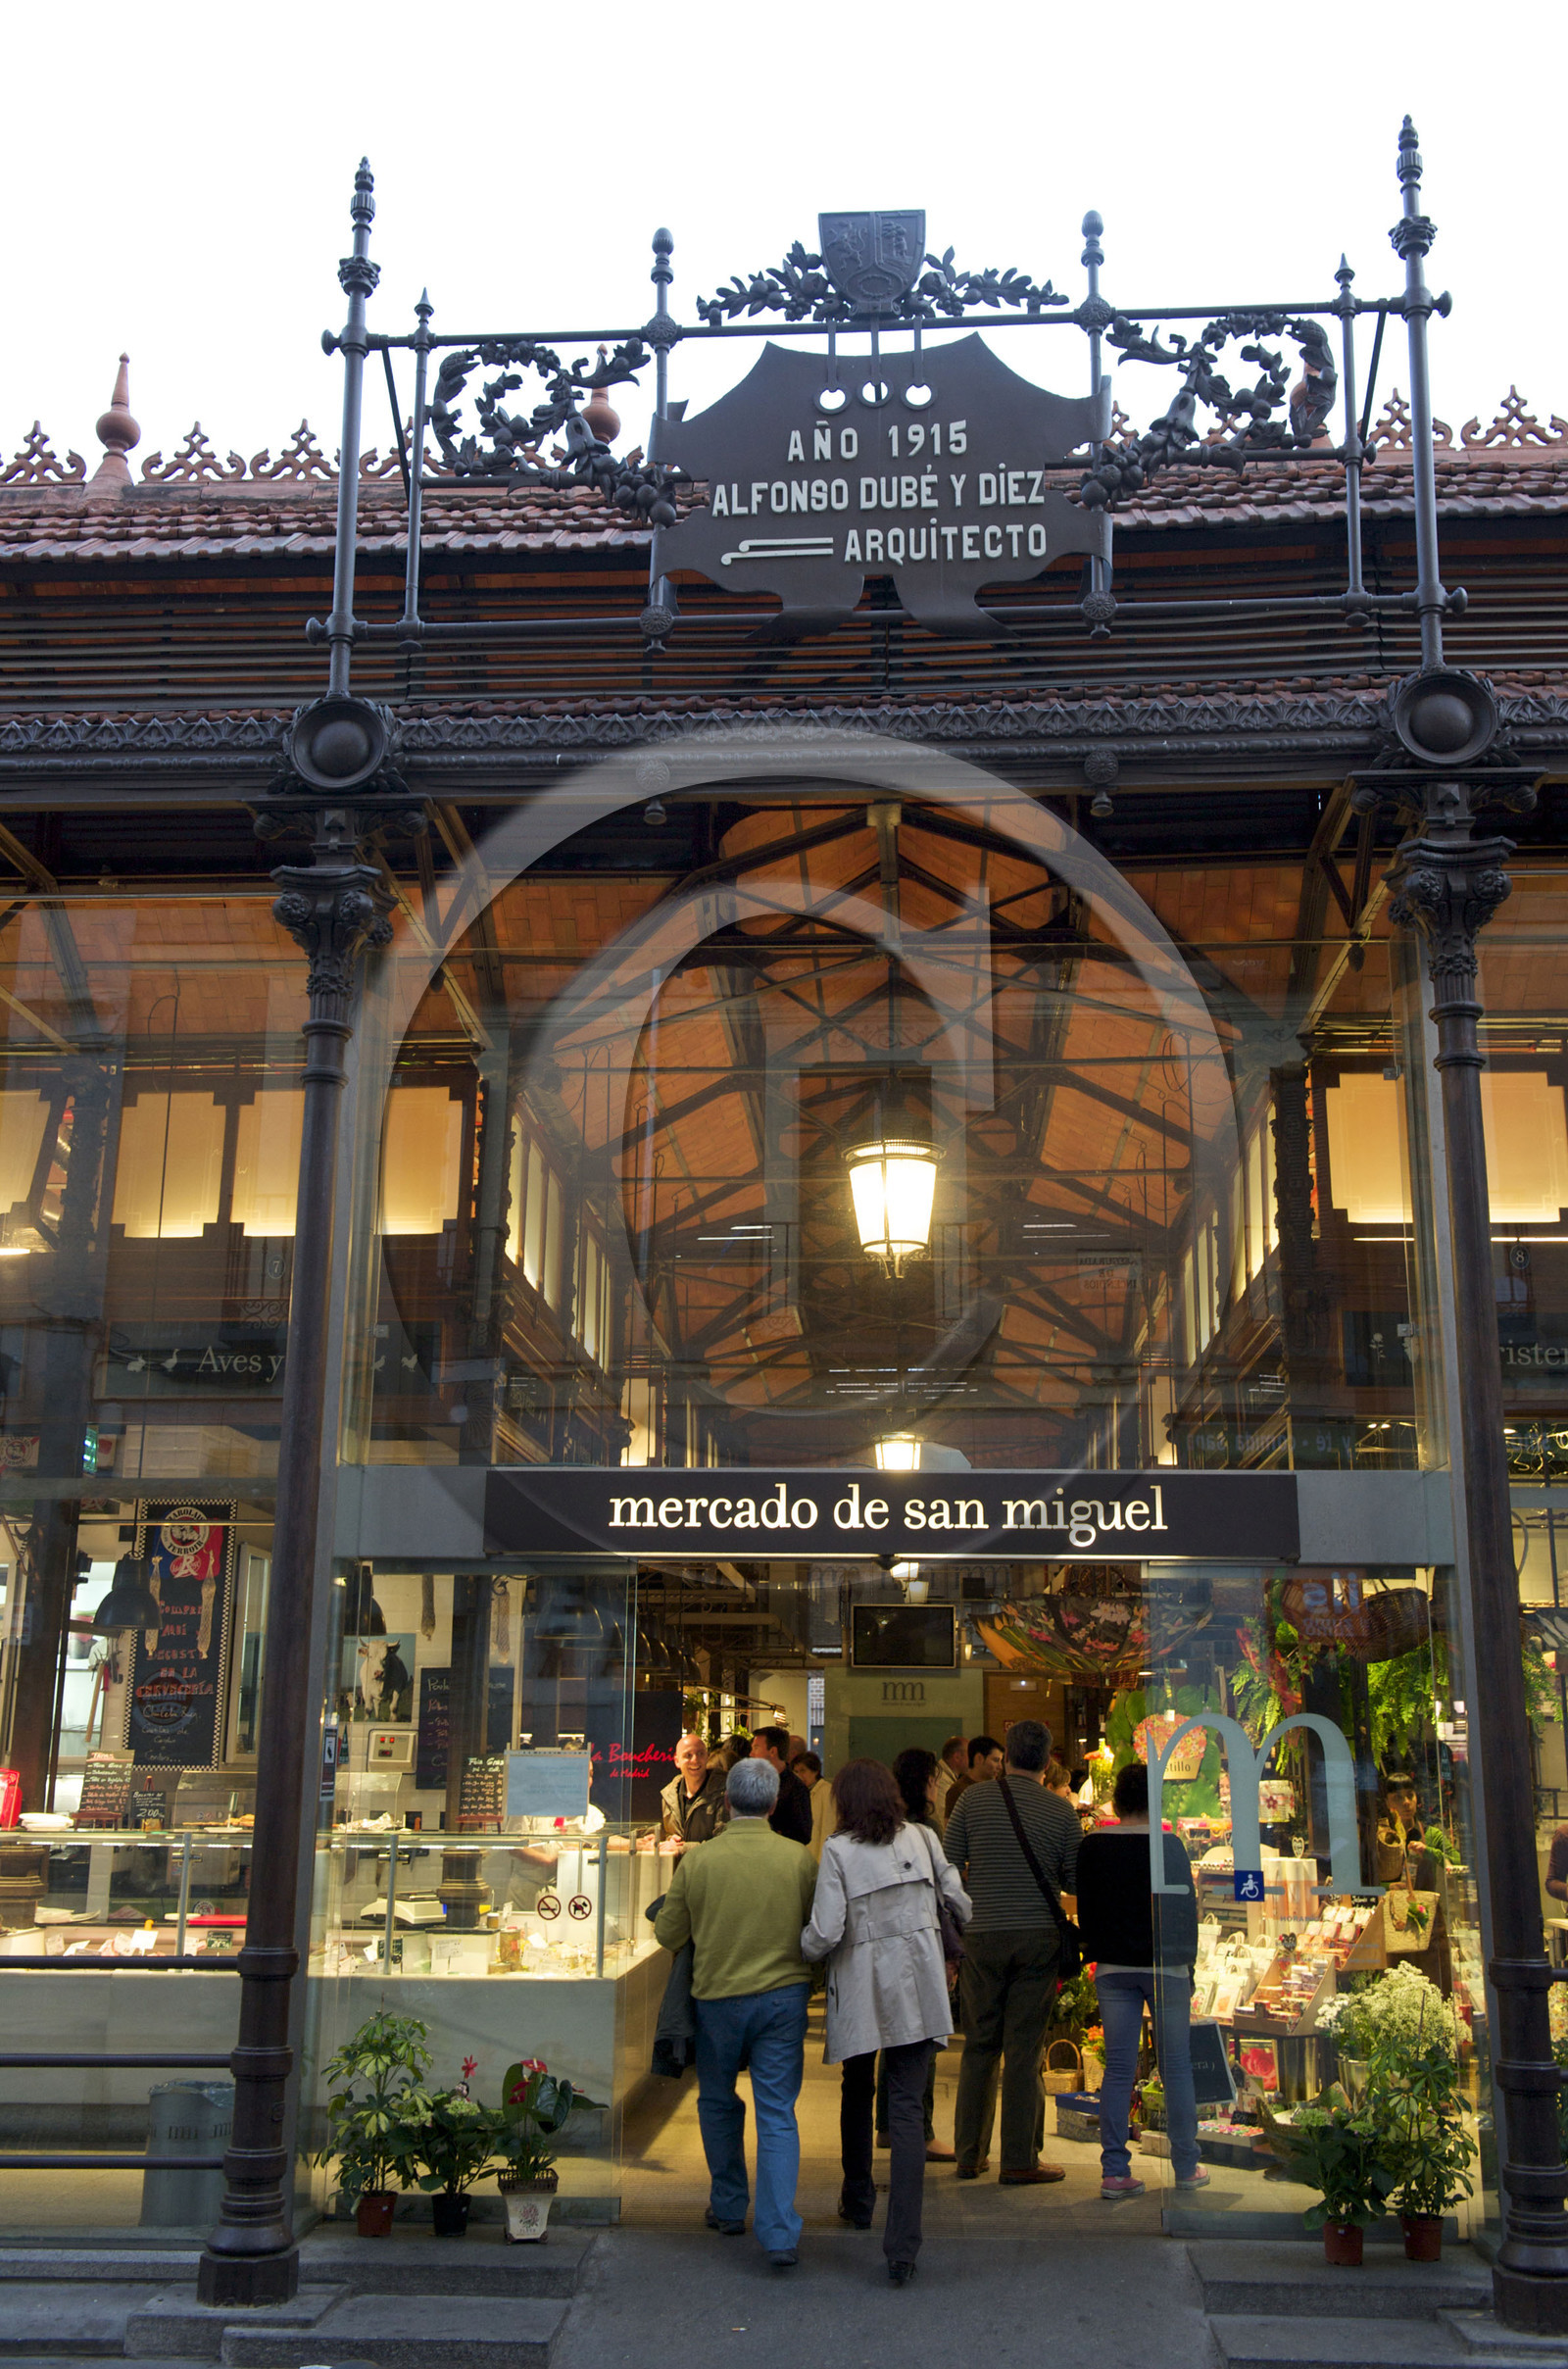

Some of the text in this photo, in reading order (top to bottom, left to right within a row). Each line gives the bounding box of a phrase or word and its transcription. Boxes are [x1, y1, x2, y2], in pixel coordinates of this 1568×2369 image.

[787, 420, 967, 463] AÑO 1915
[711, 478, 849, 518] ALFONSO
[859, 465, 938, 511] DUBÉ
[951, 473, 966, 508] Y
[196, 1346, 283, 1383] Aves y
[609, 1483, 1168, 1548] mercado de san miguel
[168, 1541, 204, 1555] TERROIR
[608, 1743, 676, 1762] Boucheri
[620, 1768, 650, 1778] Madrid
